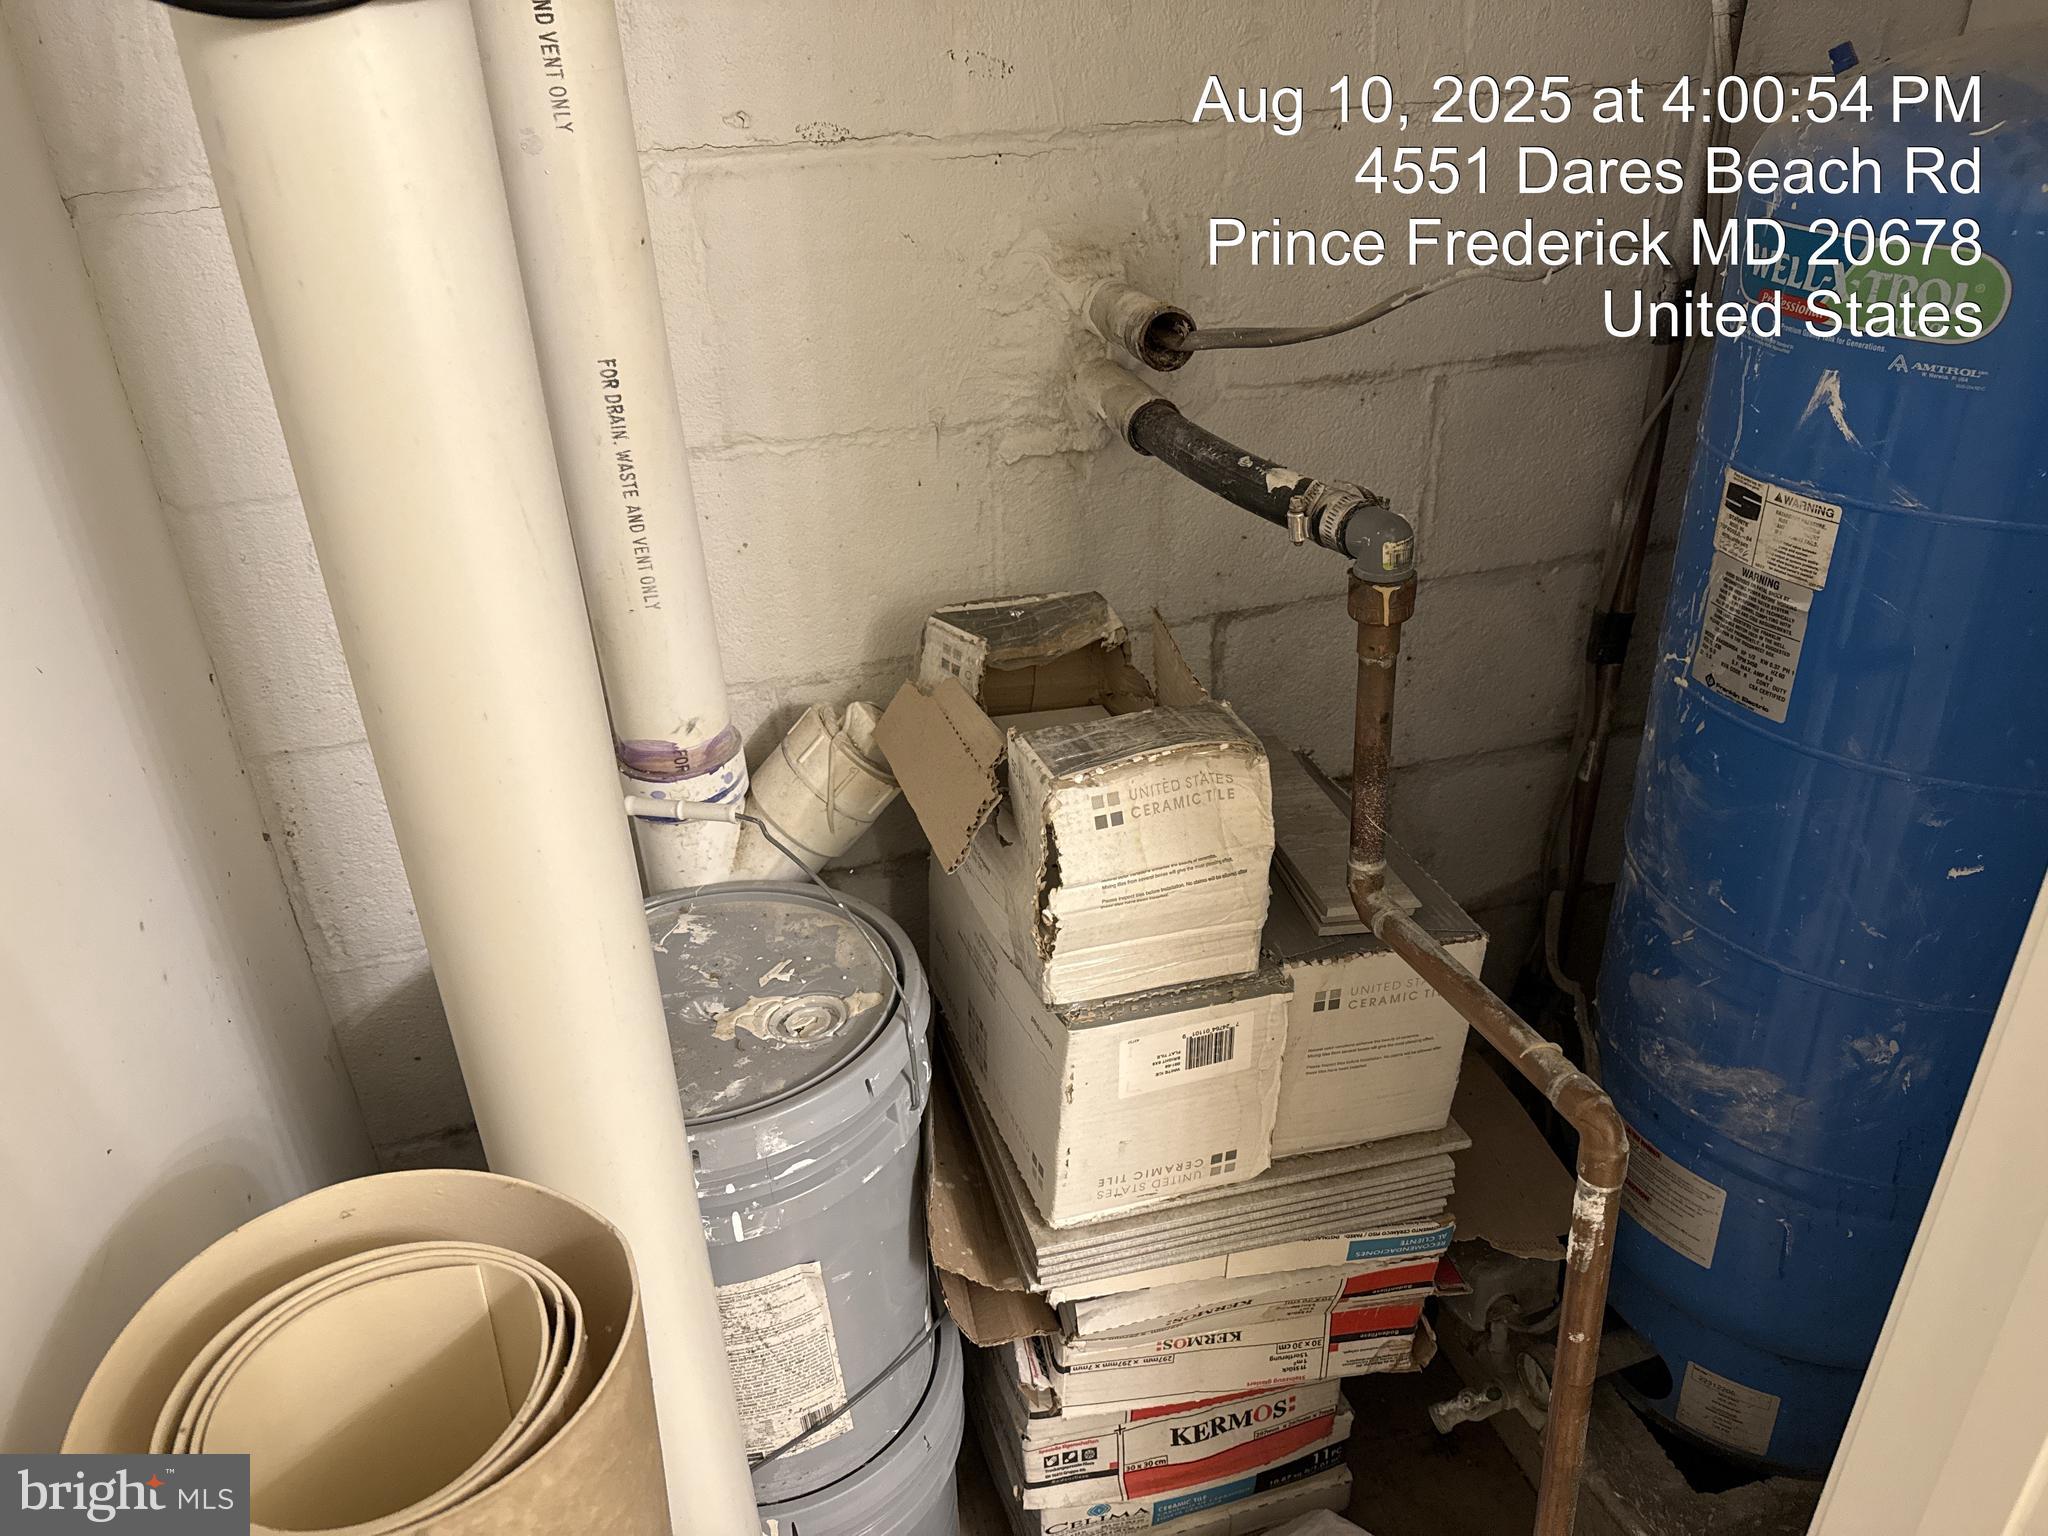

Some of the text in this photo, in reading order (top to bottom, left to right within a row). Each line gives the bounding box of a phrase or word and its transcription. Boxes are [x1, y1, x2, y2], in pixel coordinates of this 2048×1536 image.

[532, 0, 574, 134] ND VENT ONLY
[1846, 339, 1886, 352] Generations.
[597, 358, 620, 389] FOR
[1912, 362, 1980, 377] AMTROL
[616, 449, 640, 499] WASTE
[1784, 496, 1834, 518] WARNING
[625, 505, 645, 533] AND
[632, 536, 654, 571] VENT
[1742, 568, 1779, 590] WARNING
[640, 575, 661, 610] ONLY
[1715, 682, 1740, 699] Franklin
[1741, 696, 1769, 712] Electric
[1759, 688, 1785, 702] CERTIFIED
[674, 749, 690, 773] FOR
[1128, 773, 1234, 801] UNITED STATES
[1130, 788, 1236, 819] CERAMIC TILE
[1348, 990, 1418, 1010] CERAMIC
[1350, 981, 1401, 996] UNITED
[1098, 1158, 1204, 1187] CERAMIC TILE
[1097, 1170, 1201, 1200] UNITED STATES
[1355, 1238, 1445, 1257] RECOMENDACIONES
[1400, 1236, 1435, 1245] CLIENTE
[1162, 1330, 1242, 1350] KERMOS
[1360, 1329, 1399, 1337] Bodenfliese
[1292, 1341, 1303, 1349] 30
[1102, 1359, 1131, 1367] 297mm
[1143, 1355, 1172, 1363] 297mm
[1170, 1399, 1288, 1447] KERMOS
[1044, 1506, 1149, 1534] CELIMA
